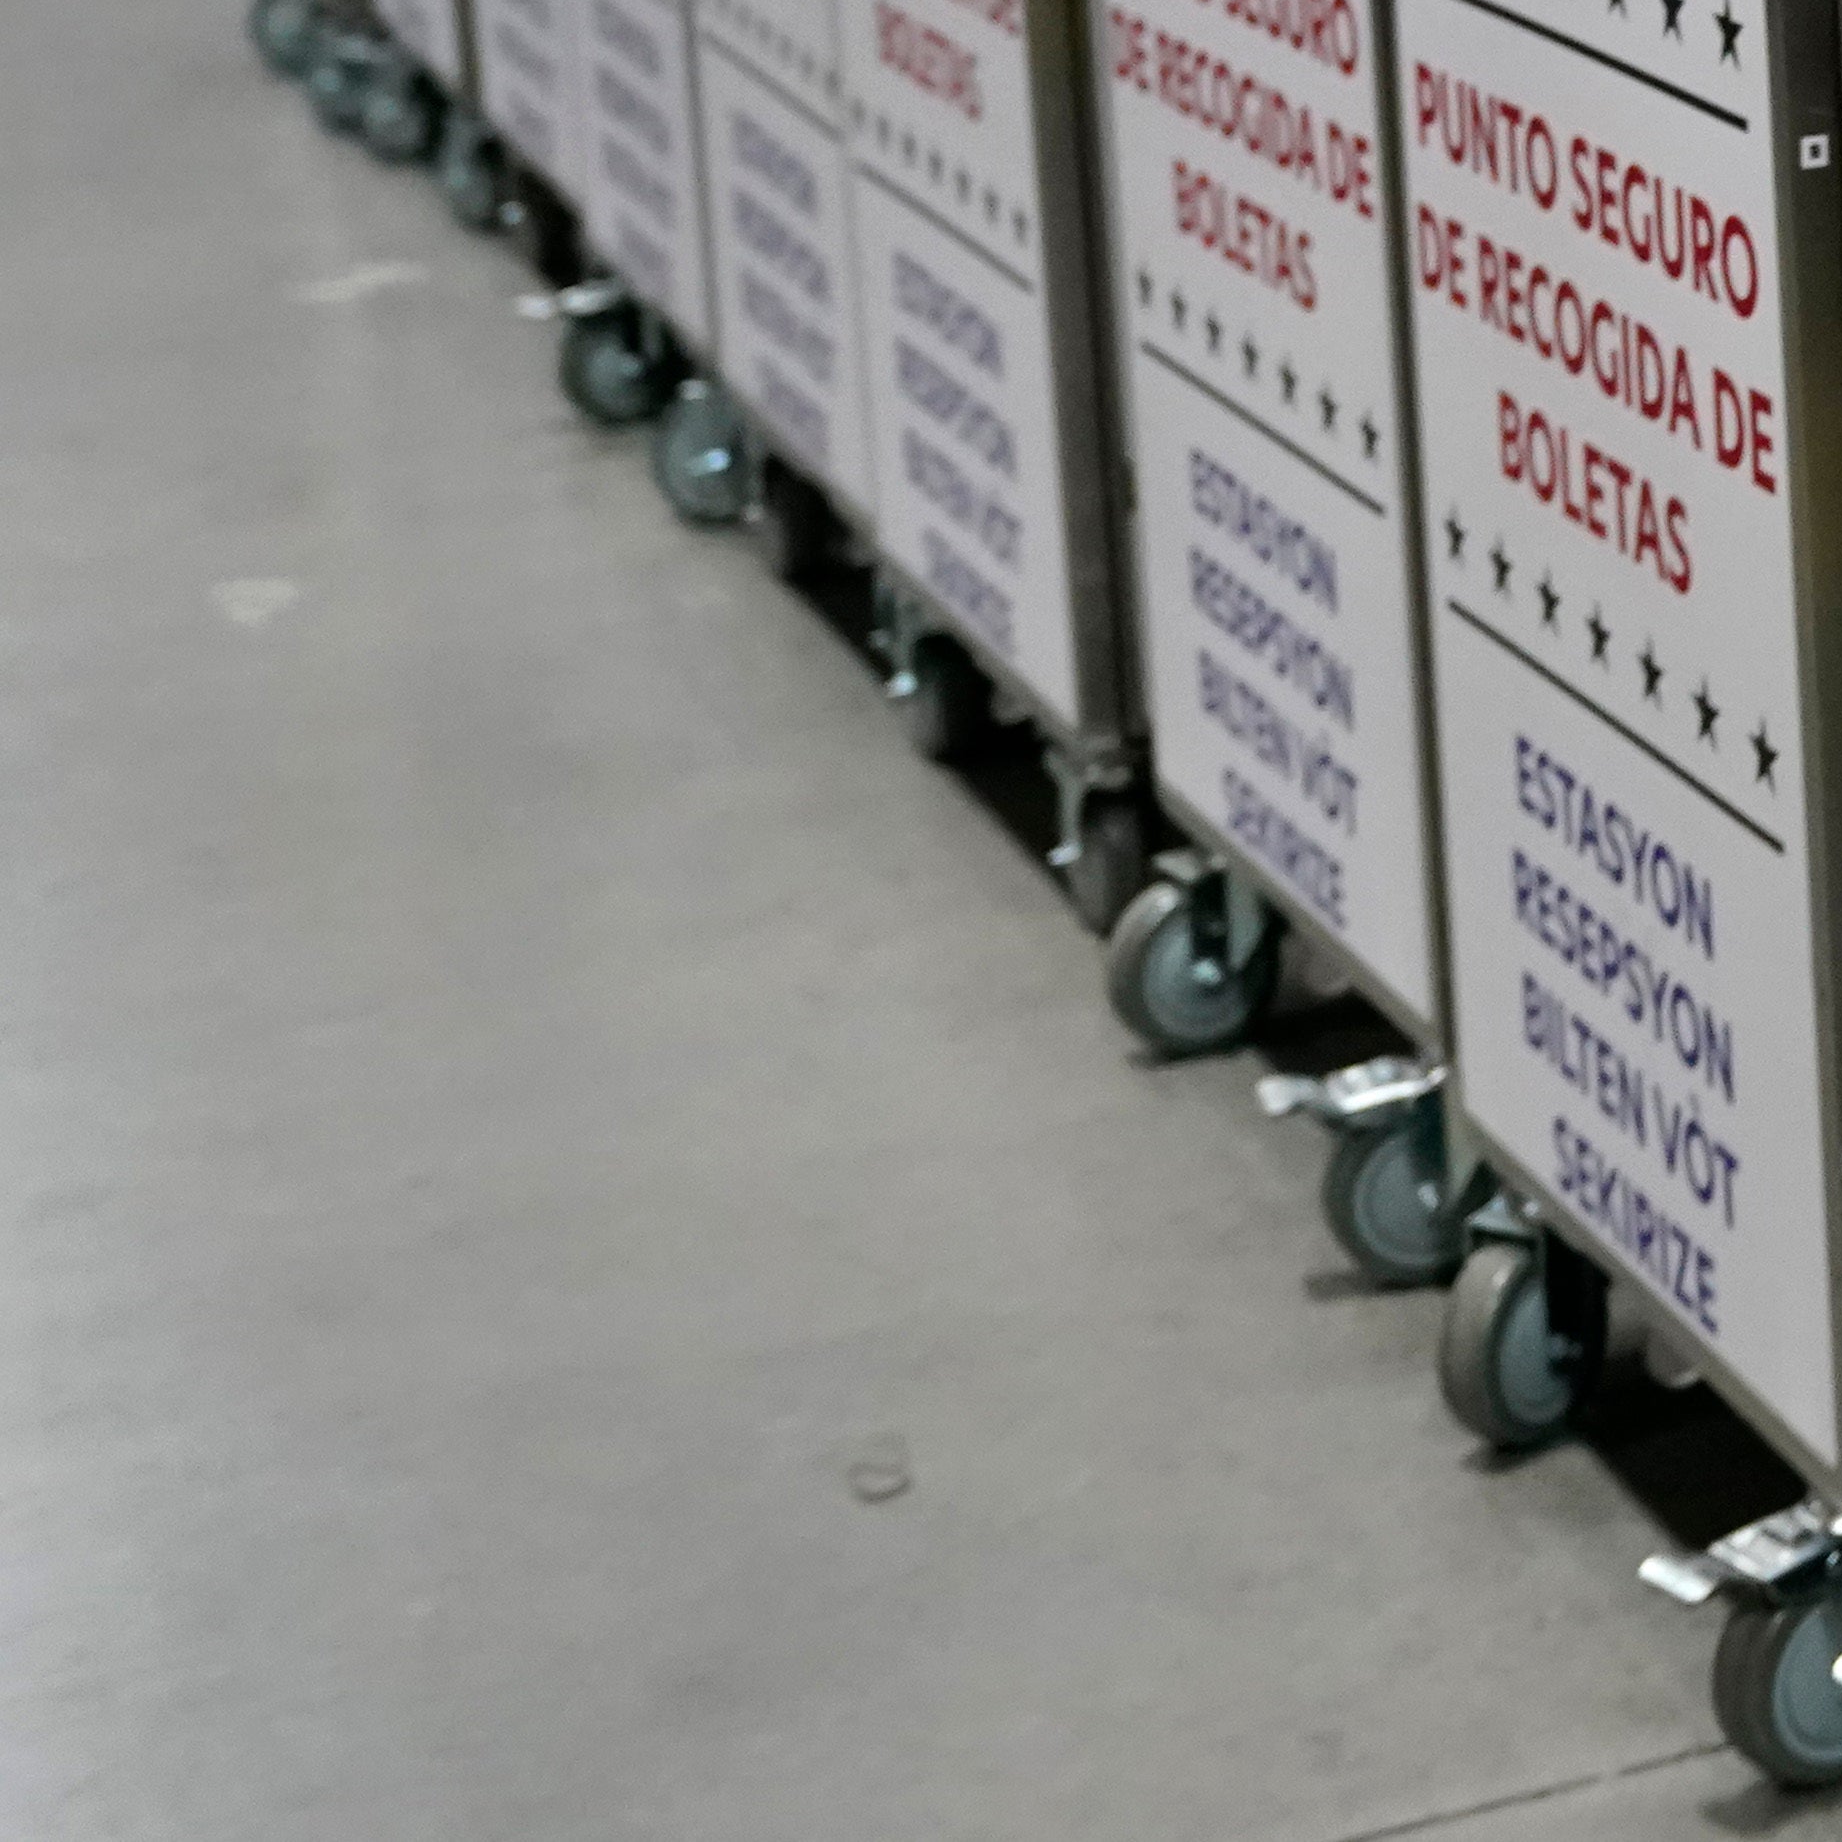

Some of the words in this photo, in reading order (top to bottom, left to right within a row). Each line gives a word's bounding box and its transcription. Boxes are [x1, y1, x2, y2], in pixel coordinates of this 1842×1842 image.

[1416, 63, 1557, 210] PUNTO
[1571, 137, 1758, 318] SEGURO
[1418, 205, 1467, 308] DE
[1479, 237, 1700, 448] RECOGIDA
[1713, 369, 1775, 494] DE
[1499, 392, 1691, 594] BOLETAS
[1516, 736, 1713, 958] ESTASYON
[1513, 851, 1733, 1101] RESEPSYON
[1523, 974, 1646, 1145] BILTEN
[1554, 1118, 1717, 1334] SEKIRIZE
